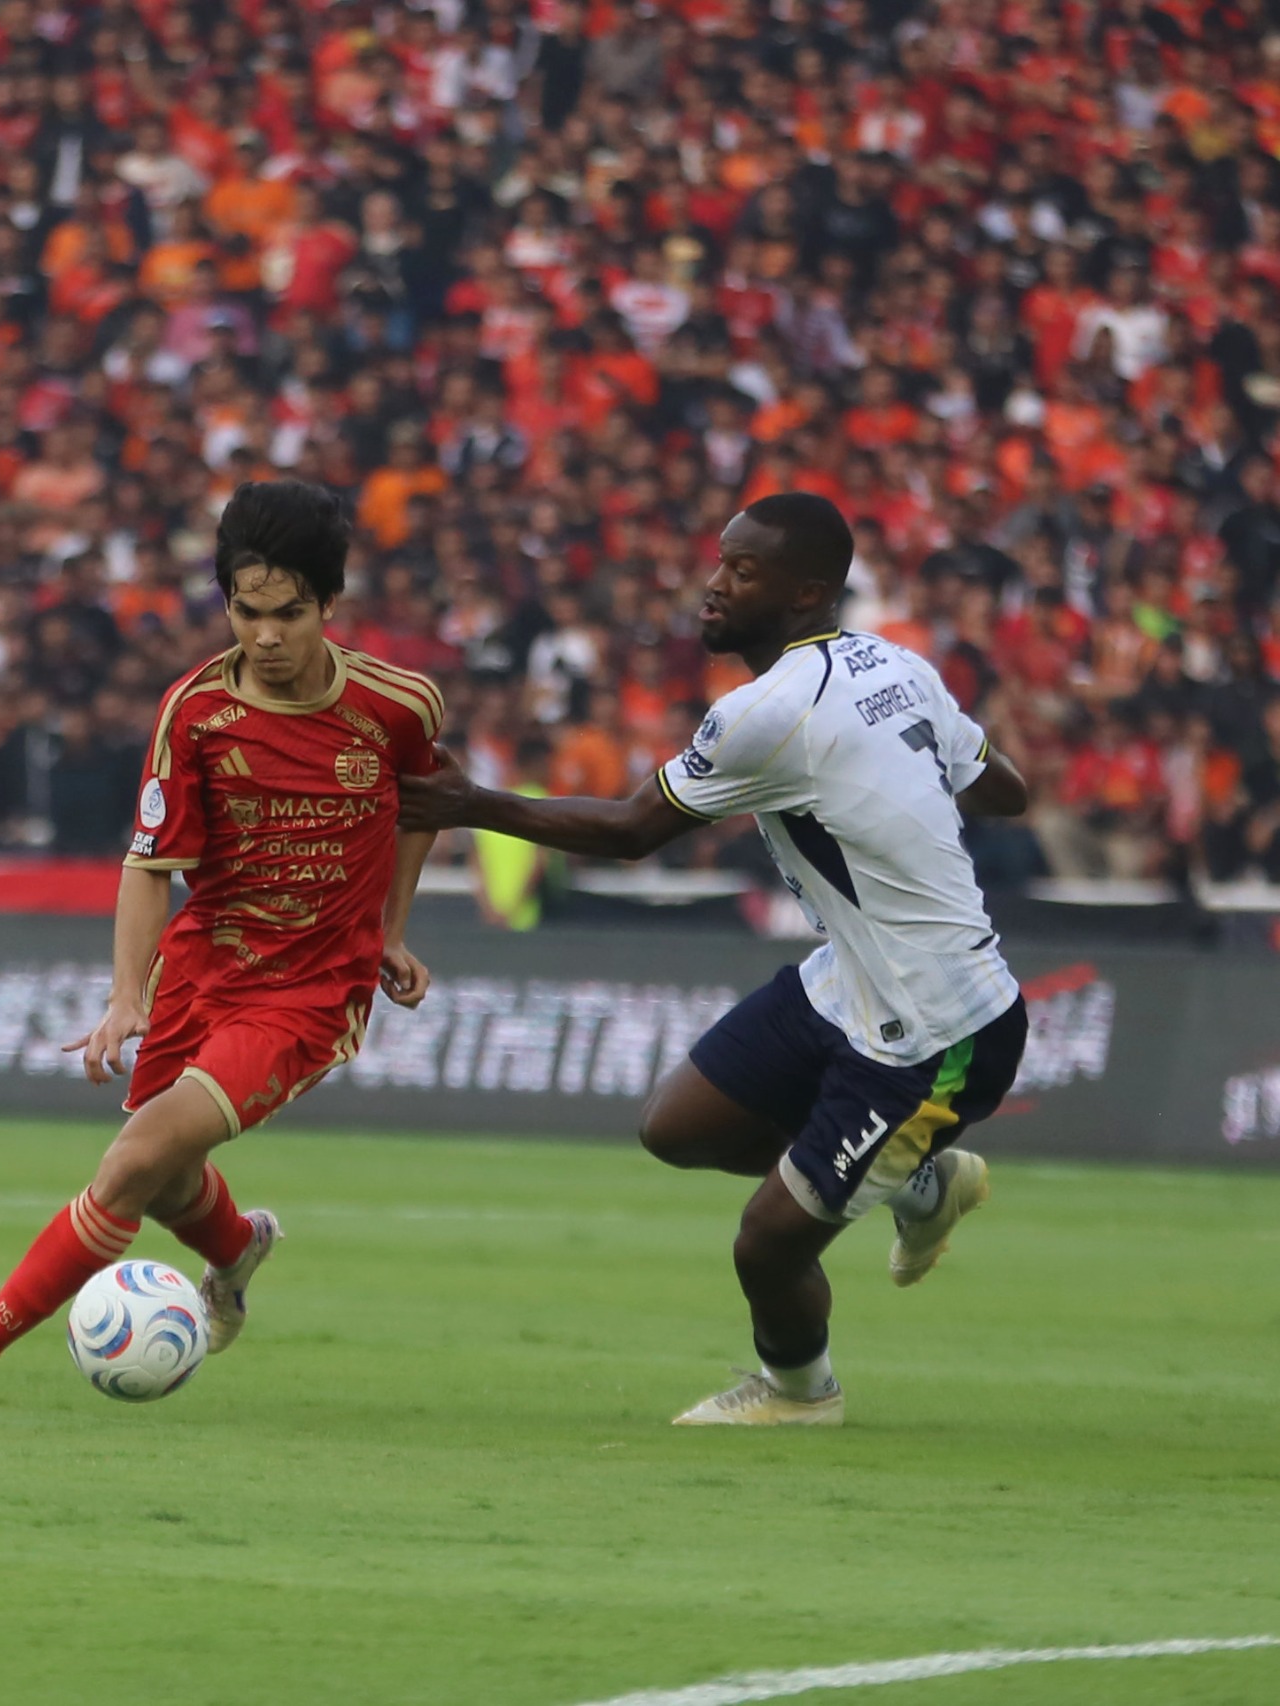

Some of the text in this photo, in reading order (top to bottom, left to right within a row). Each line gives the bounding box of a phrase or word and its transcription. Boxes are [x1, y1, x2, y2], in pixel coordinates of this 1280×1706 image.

[843, 644, 888, 678] ABC
[854, 683, 916, 727] GABRIEL
[270, 797, 379, 817] MACAN
[286, 864, 348, 882] JAYA
